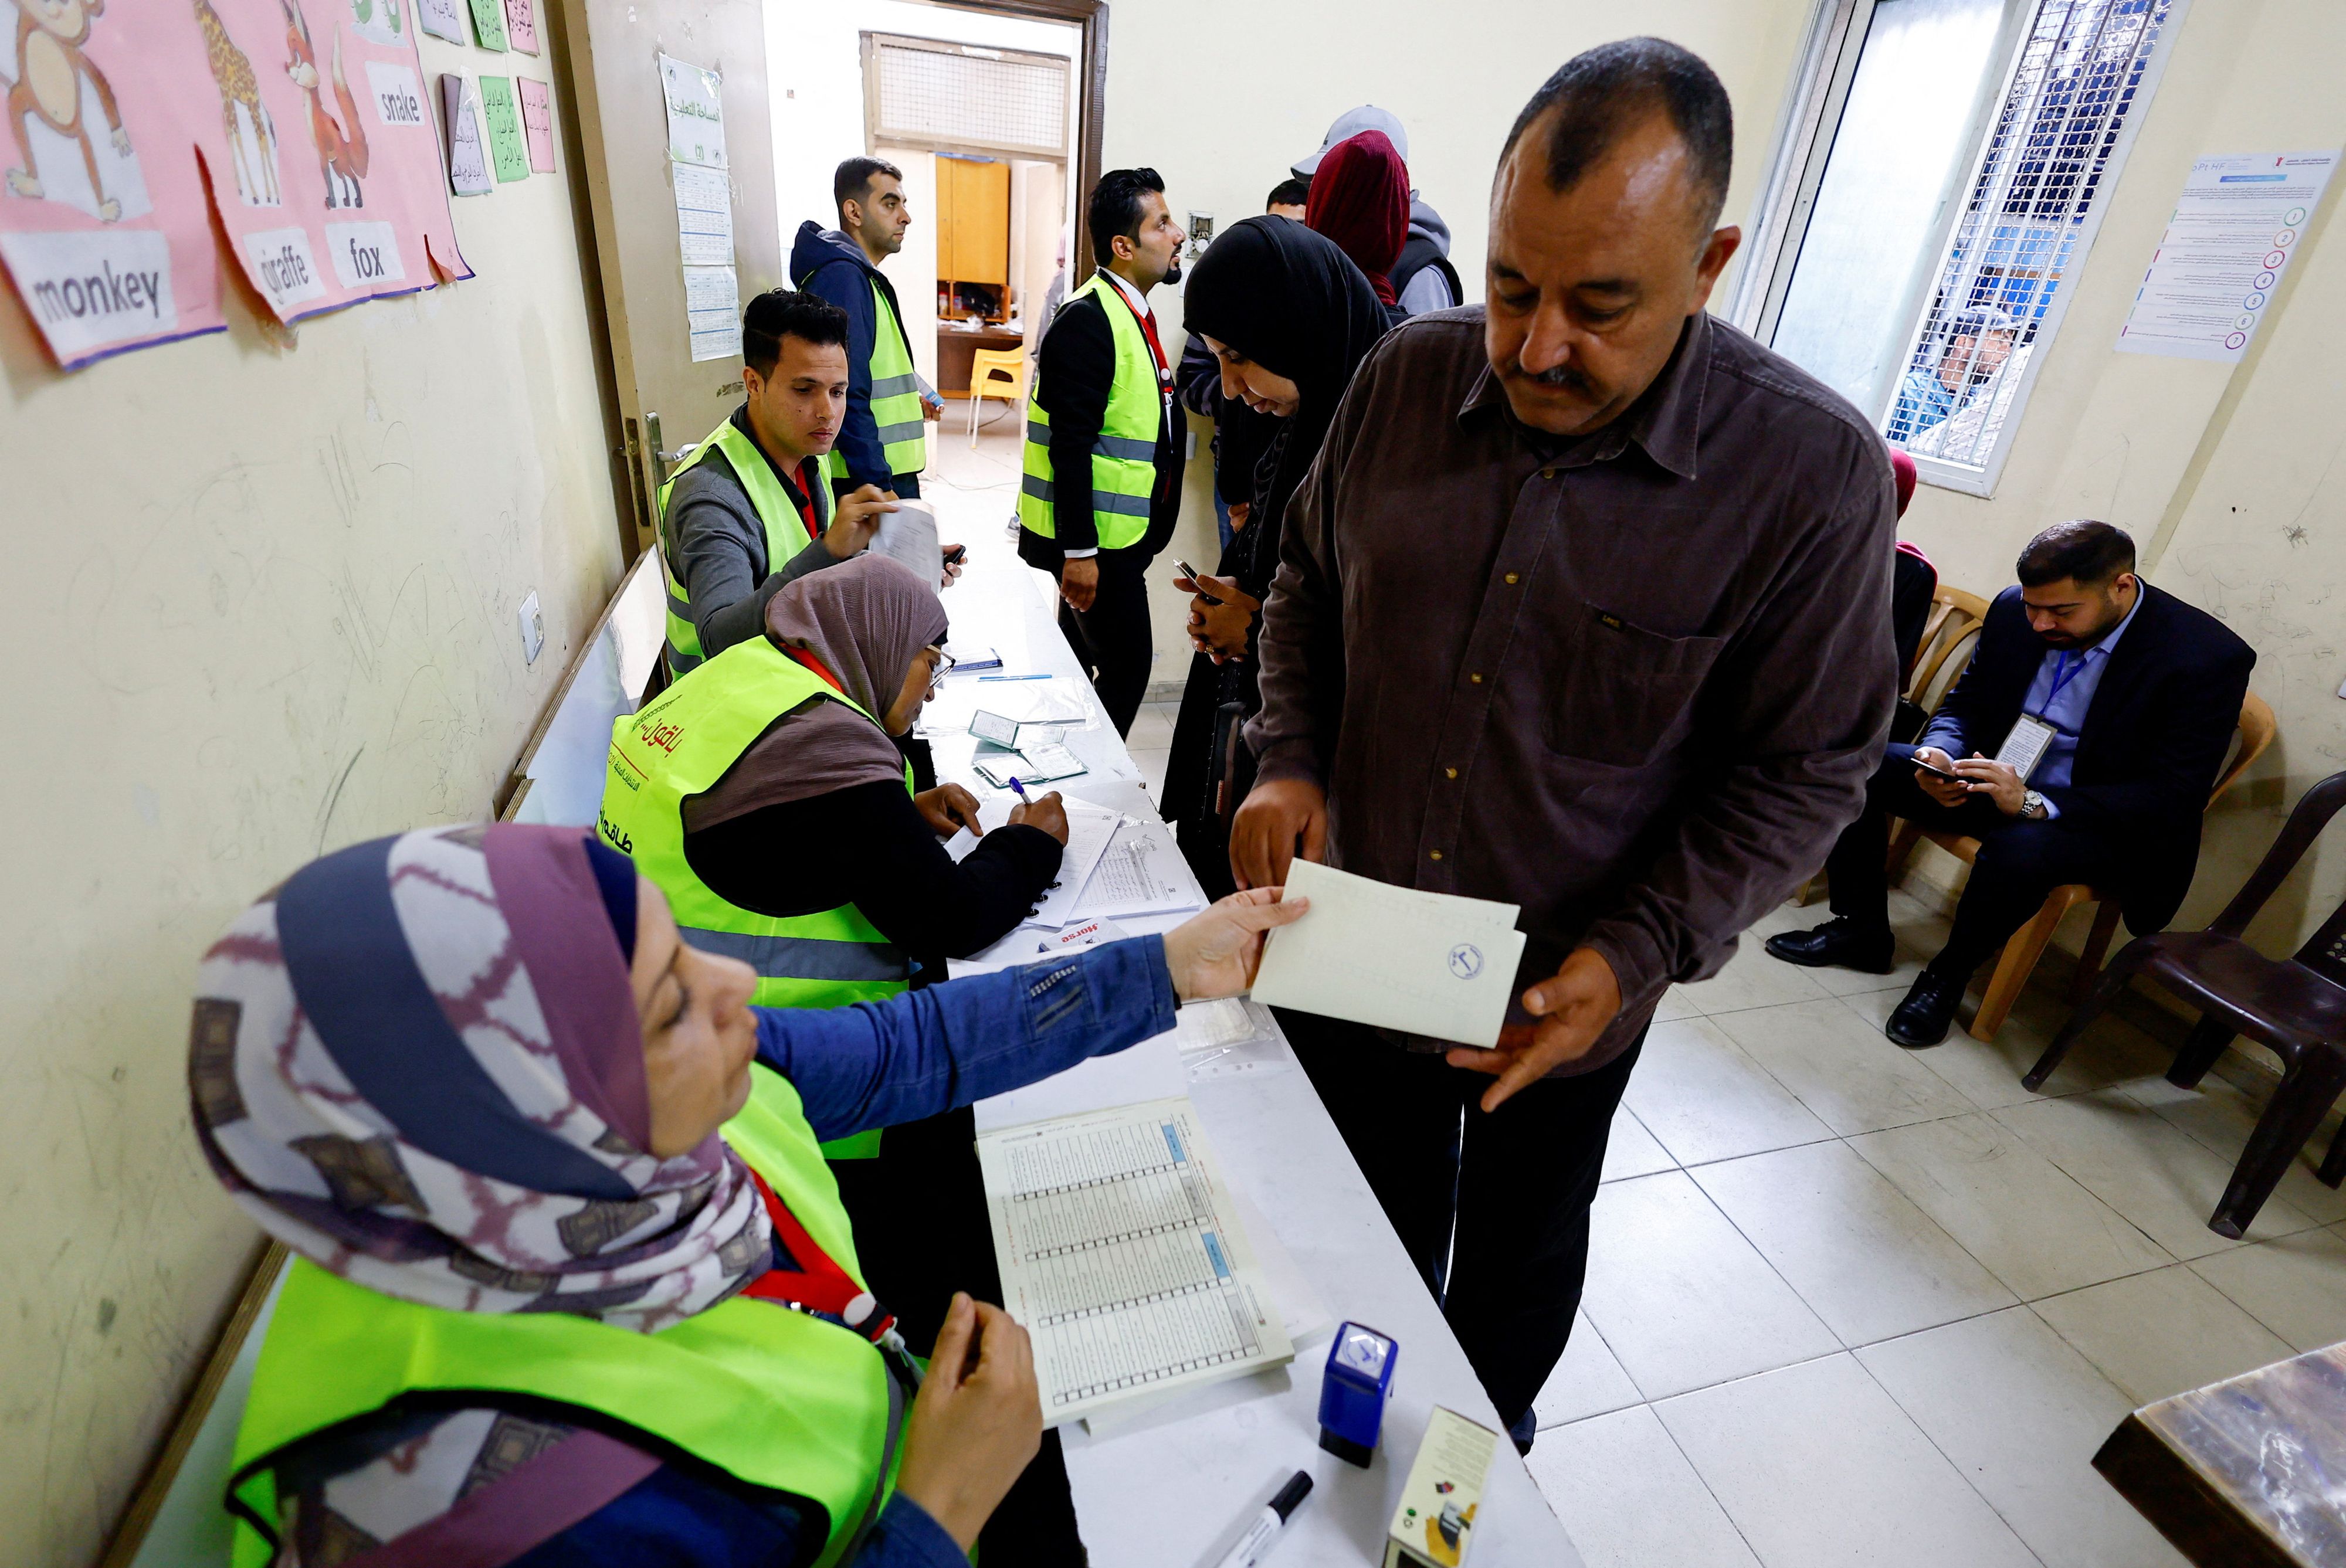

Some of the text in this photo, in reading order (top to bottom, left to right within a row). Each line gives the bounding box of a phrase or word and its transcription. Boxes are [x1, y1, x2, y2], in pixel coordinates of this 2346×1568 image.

[381, 83, 420, 123] snake
[260, 245, 310, 307] giraffe
[350, 239, 384, 279] fox
[33, 260, 160, 324] monkey
[1061, 922, 1099, 943] Horse
